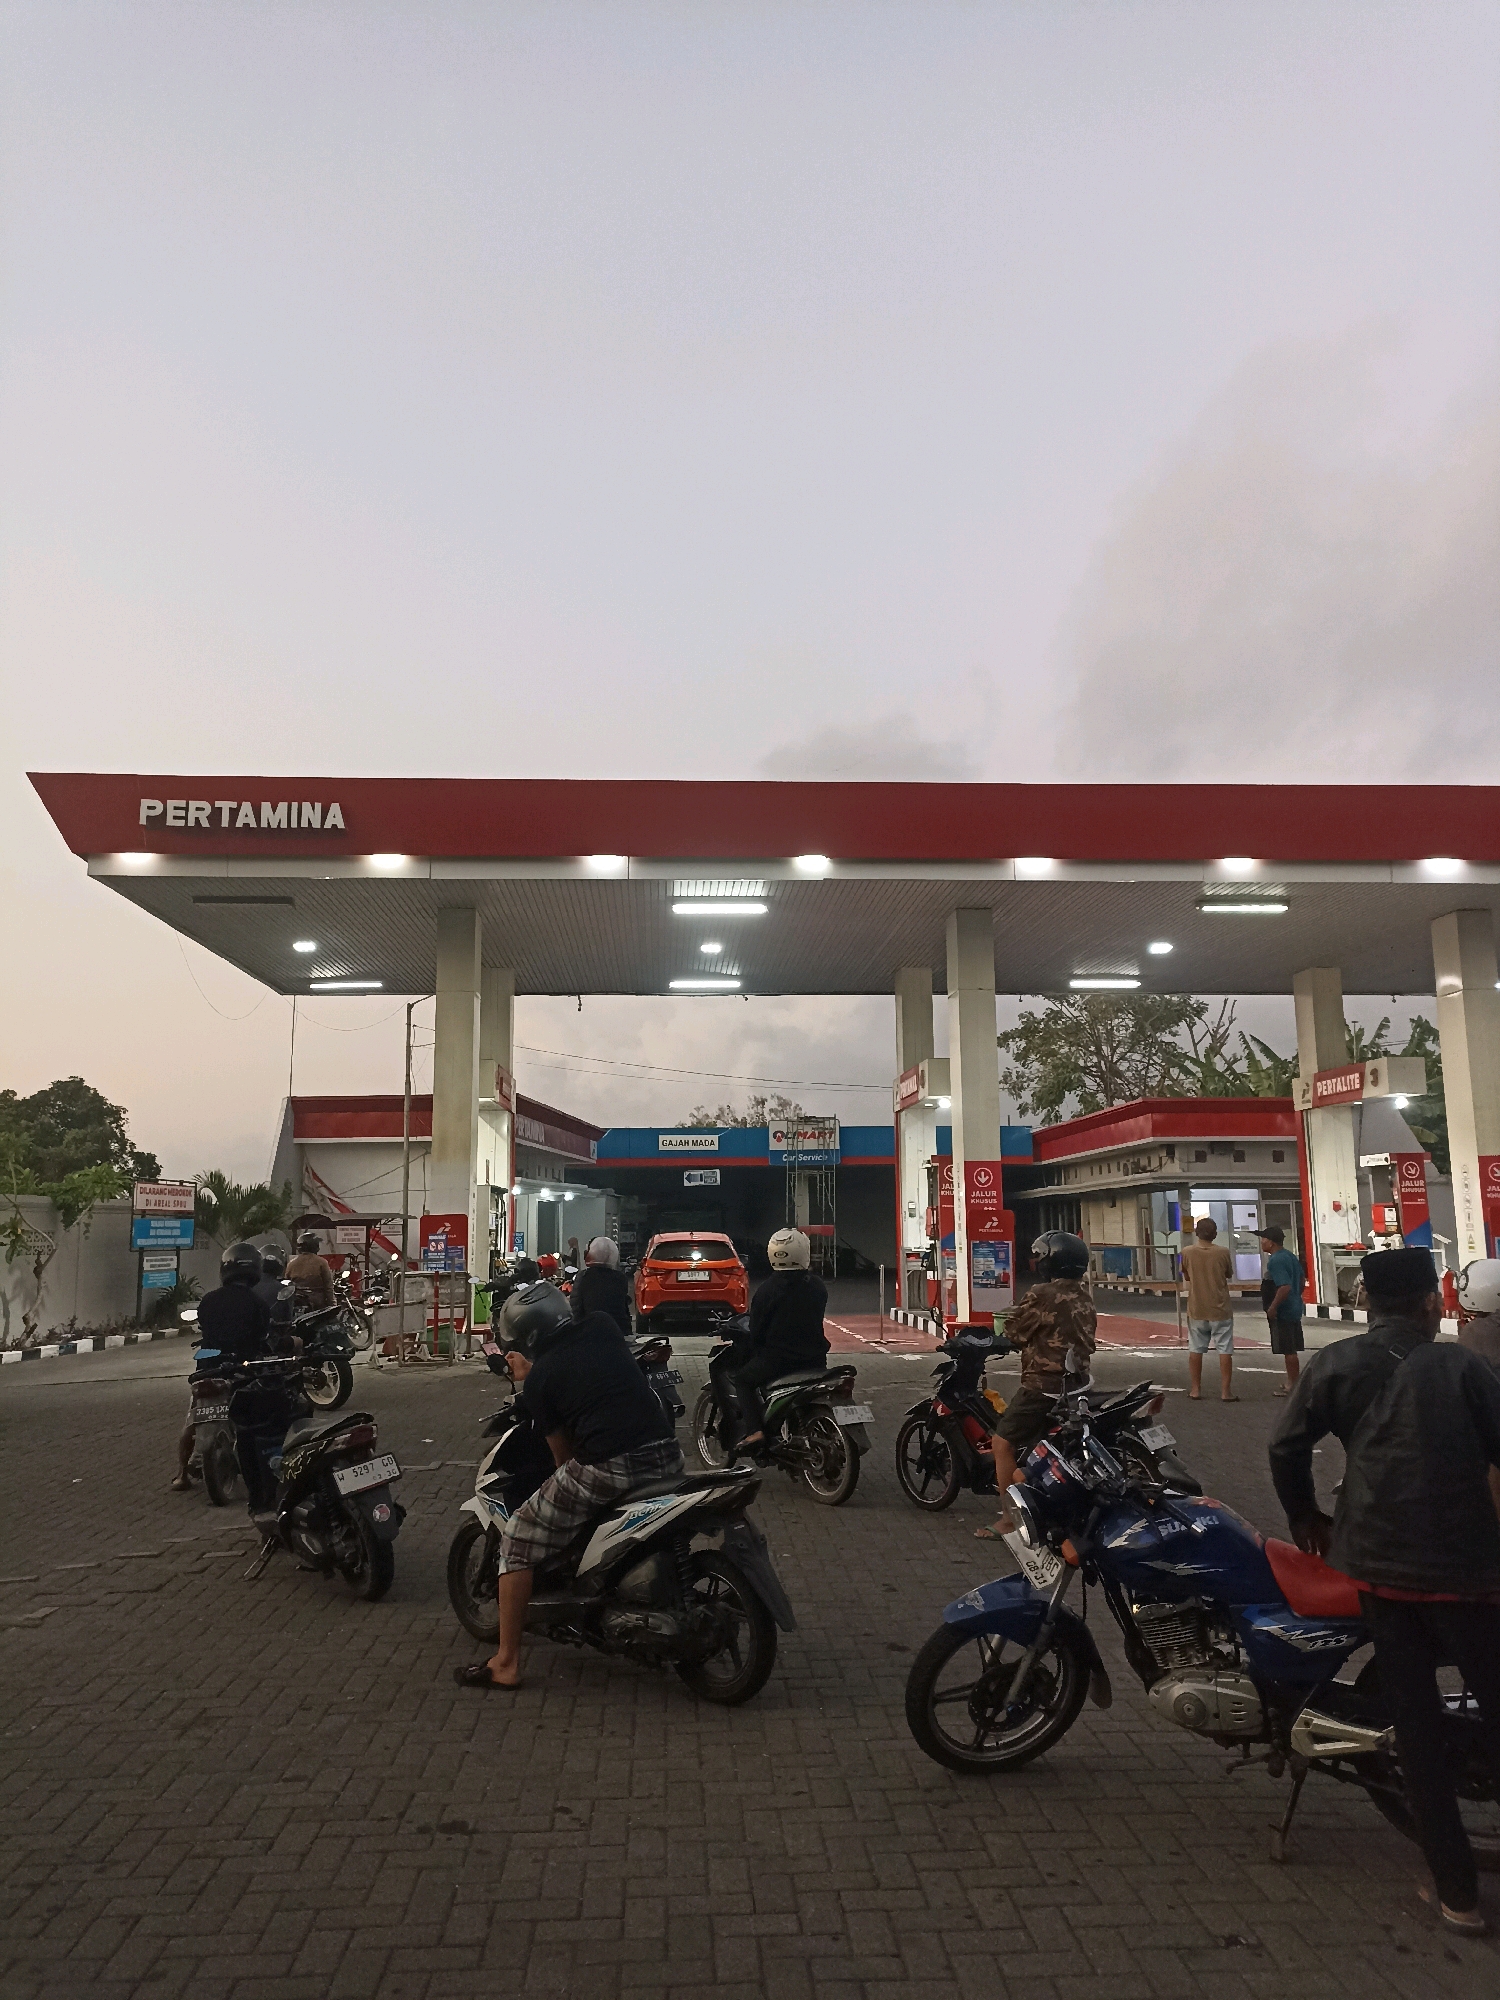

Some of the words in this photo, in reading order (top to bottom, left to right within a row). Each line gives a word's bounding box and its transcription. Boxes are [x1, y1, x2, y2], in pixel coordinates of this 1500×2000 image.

[139, 799, 345, 829] PERTAMINA
[1316, 1073, 1360, 1097] PERTALITE
[661, 1139, 689, 1147] GAJAH
[691, 1139, 715, 1147] MADA
[140, 1186, 168, 1196] DILARANG
[145, 1199, 152, 1207] DI
[337, 1472, 345, 1482] W
[352, 1462, 375, 1478] 5297
